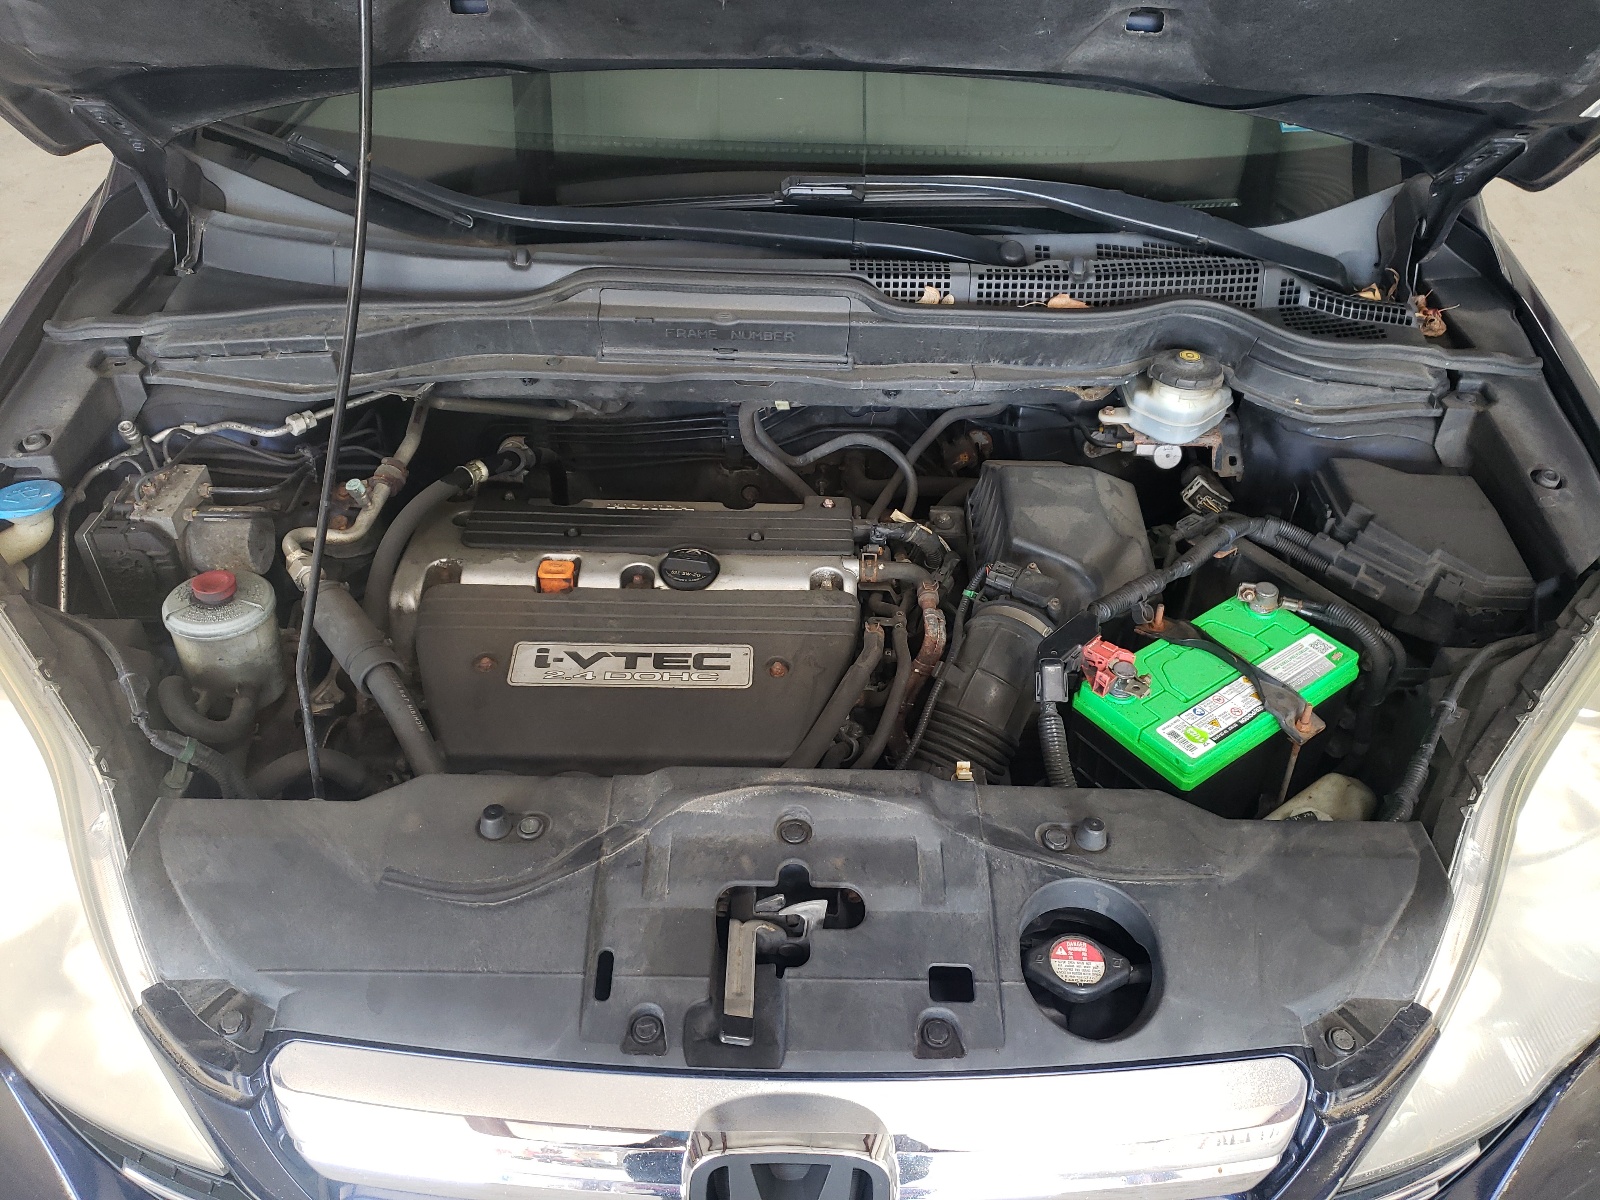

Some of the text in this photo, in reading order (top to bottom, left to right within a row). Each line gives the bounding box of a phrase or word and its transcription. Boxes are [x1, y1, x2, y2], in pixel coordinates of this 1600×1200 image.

[665, 328, 795, 342] FRAME NUMBER
[534, 648, 731, 671] i-VTEC
[542, 670, 720, 682] 2.4 DOHC
